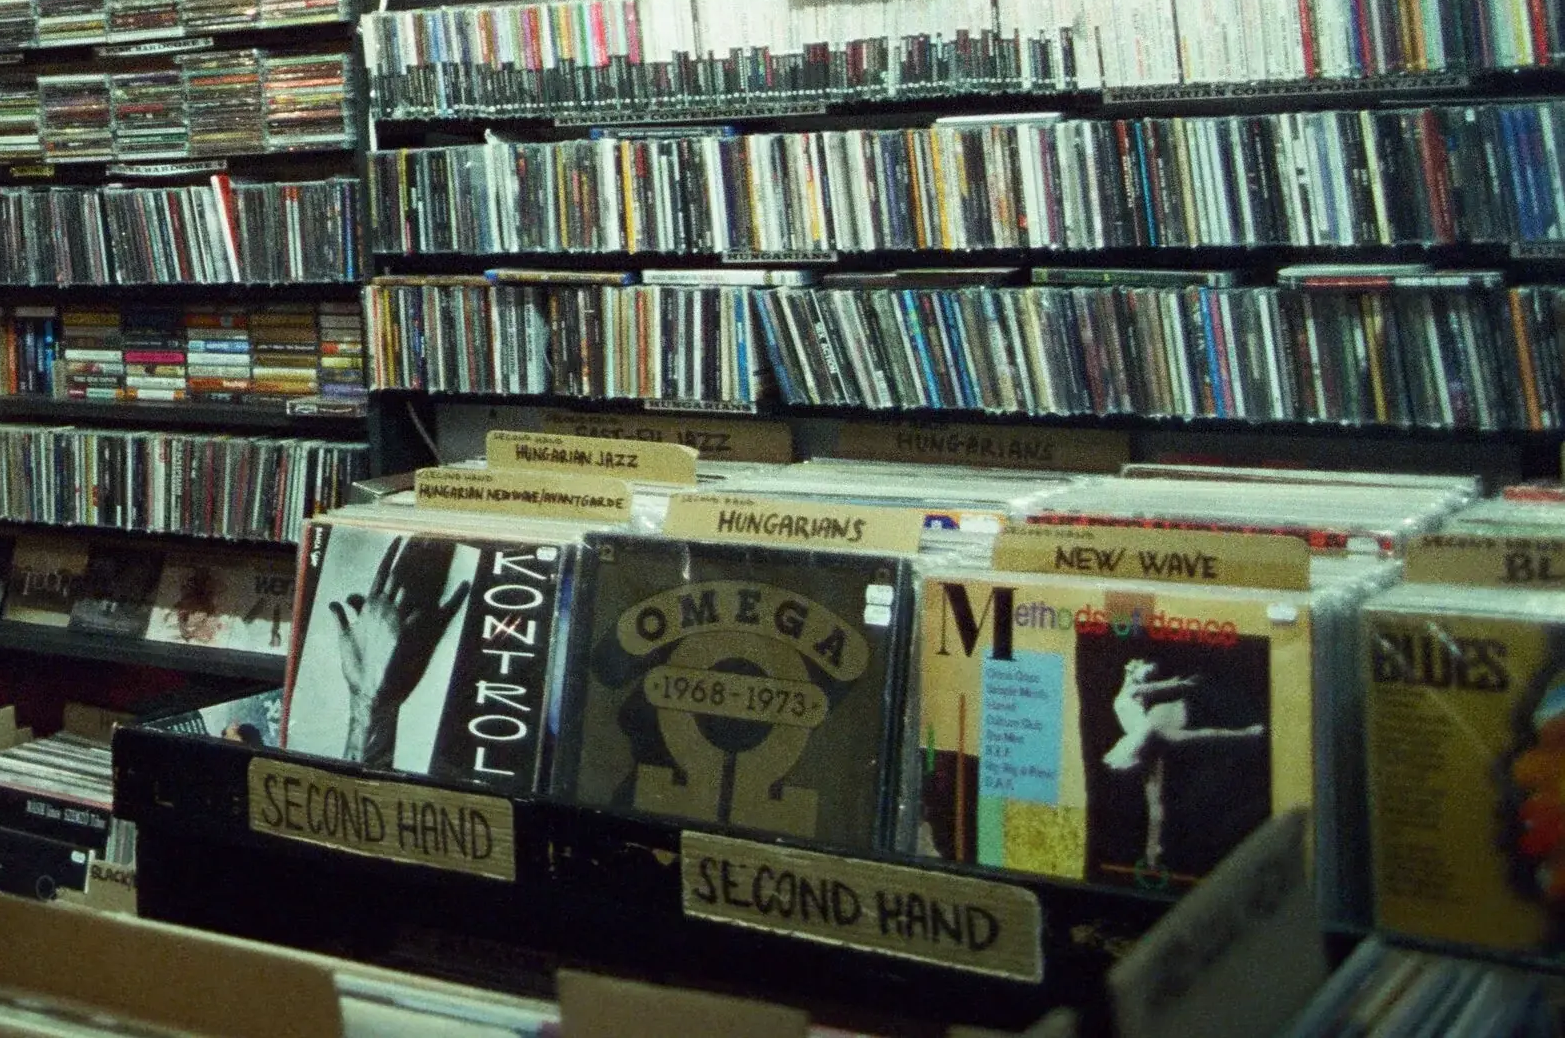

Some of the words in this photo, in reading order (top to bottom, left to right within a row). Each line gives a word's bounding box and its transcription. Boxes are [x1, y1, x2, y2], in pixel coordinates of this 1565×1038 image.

[1112, 88, 1227, 102] HUNGARIAN
[515, 444, 594, 469] HUNGARIAN
[597, 450, 639, 470] JAZZ
[677, 431, 732, 453] JAZZ
[896, 430, 1055, 462] HUNGARIANS
[418, 483, 484, 502] HUNGARIAN
[717, 511, 867, 542] HUNGARIANS
[1055, 546, 1126, 572] NEW
[1139, 550, 1219, 580] WAVE
[634, 586, 851, 669] OMEGA
[937, 581, 1109, 661] Methods
[1146, 612, 1238, 648] dance
[1373, 633, 1510, 693] BLUES
[260, 775, 386, 844] SECOND
[396, 800, 493, 860] HAND
[691, 859, 865, 929] SECOND
[875, 888, 1001, 953] HAND
